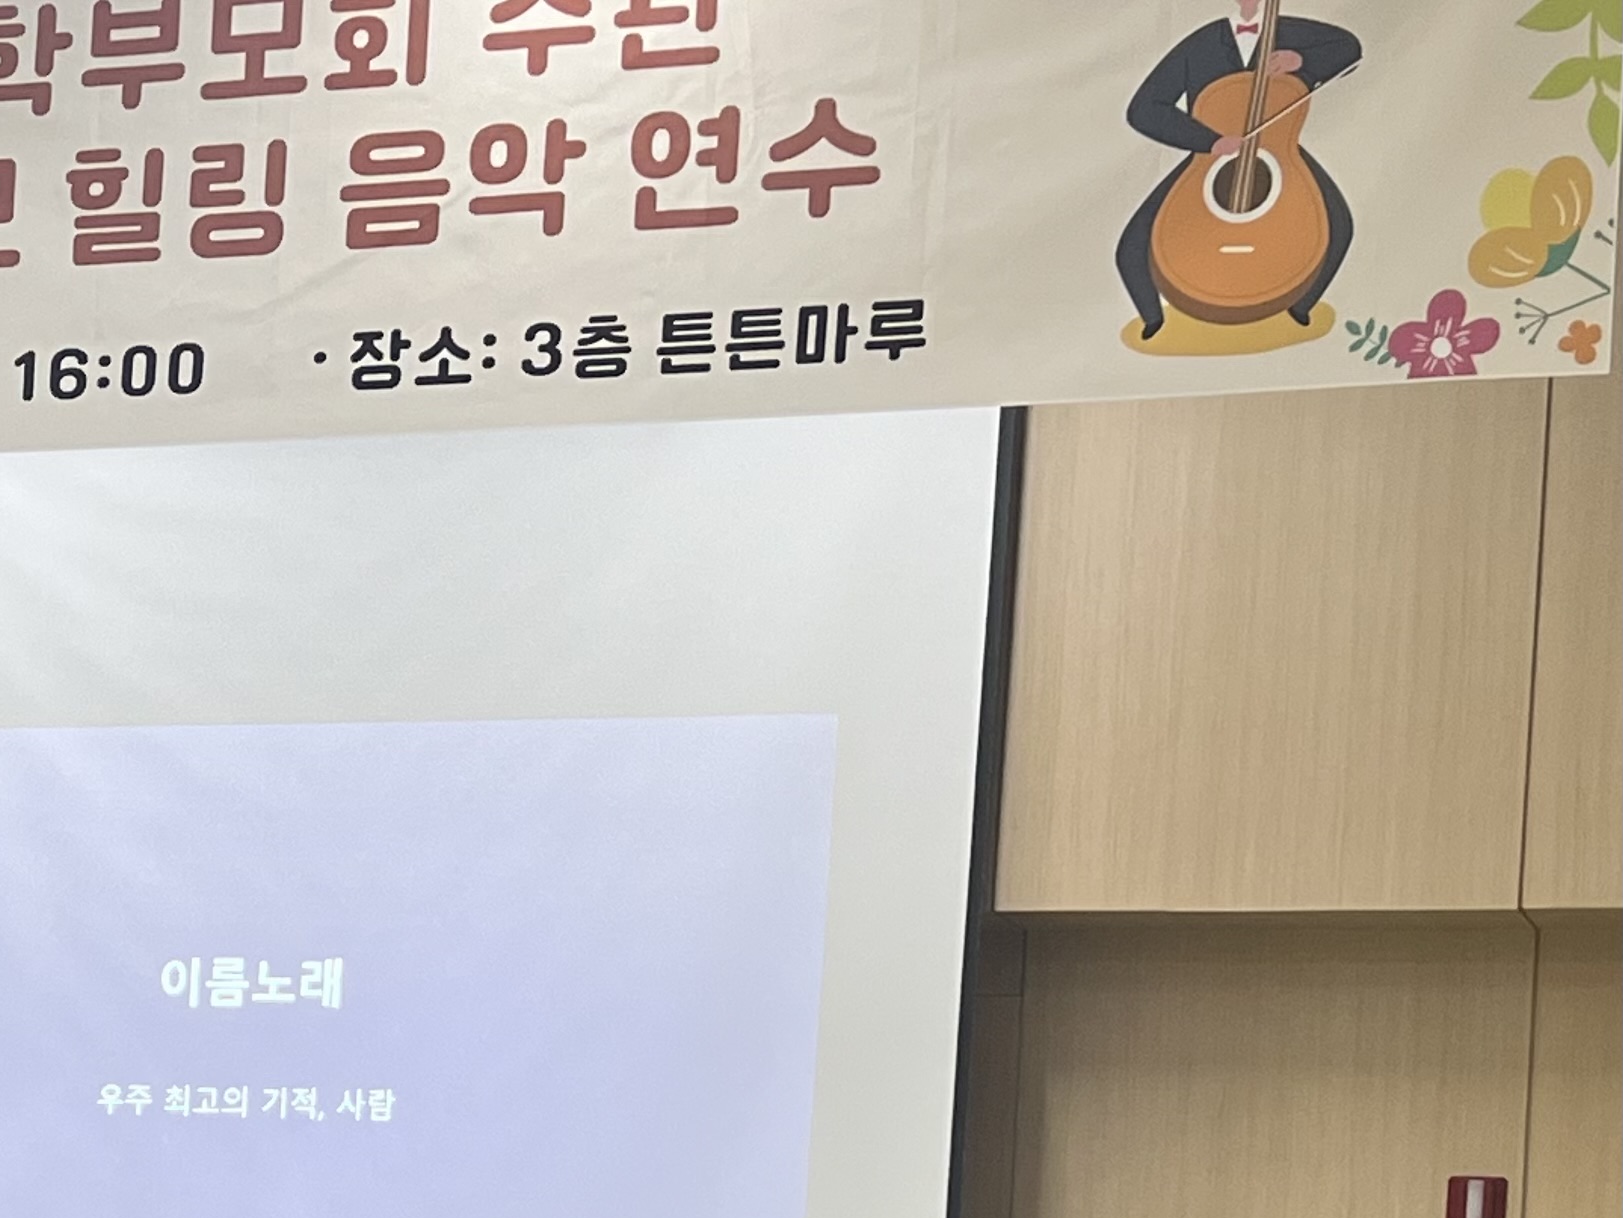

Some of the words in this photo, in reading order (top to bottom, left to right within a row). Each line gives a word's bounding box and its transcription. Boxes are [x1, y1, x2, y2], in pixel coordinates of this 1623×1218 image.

[65, 138, 288, 268] 힐링
[339, 117, 587, 252] 음악
[629, 96, 882, 232] 연수
[13, 342, 206, 402] 16:00
[348, 326, 498, 391] 장소:
[520, 315, 632, 379] 3층
[655, 299, 928, 375] 튼튼마루
[160, 956, 344, 1010] 이름노래
[96, 1083, 154, 1117] 우주
[163, 1083, 249, 1119] 최고의
[260, 1086, 326, 1122] 기적,
[336, 1087, 397, 1122] 사람
